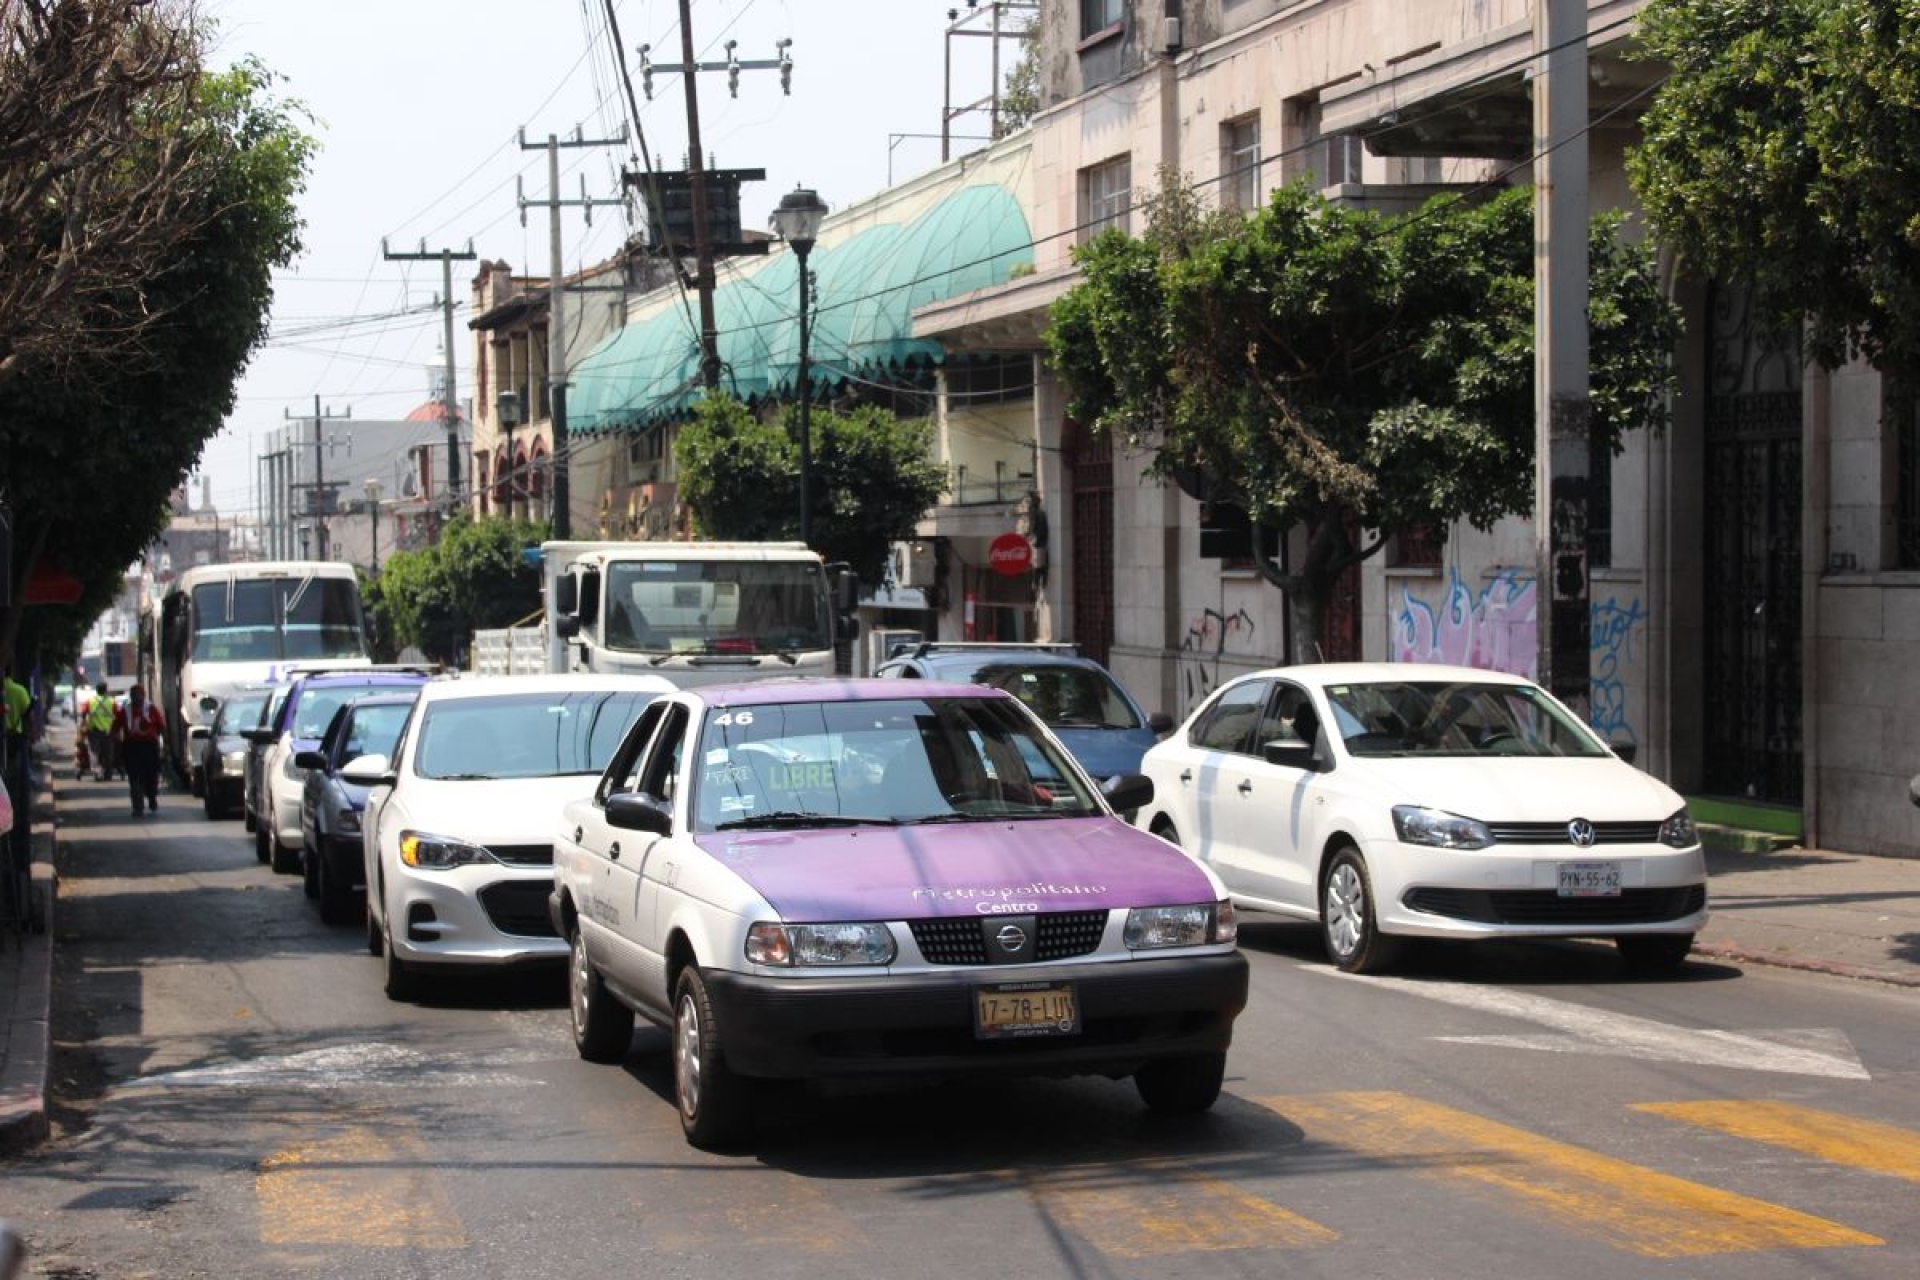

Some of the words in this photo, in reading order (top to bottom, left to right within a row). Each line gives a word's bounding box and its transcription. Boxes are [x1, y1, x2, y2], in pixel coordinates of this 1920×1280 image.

[713, 711, 753, 726] 46
[769, 764, 834, 791] LIBRE
[1561, 871, 1621, 887] PYN-55-62
[976, 902, 1038, 914] Centro
